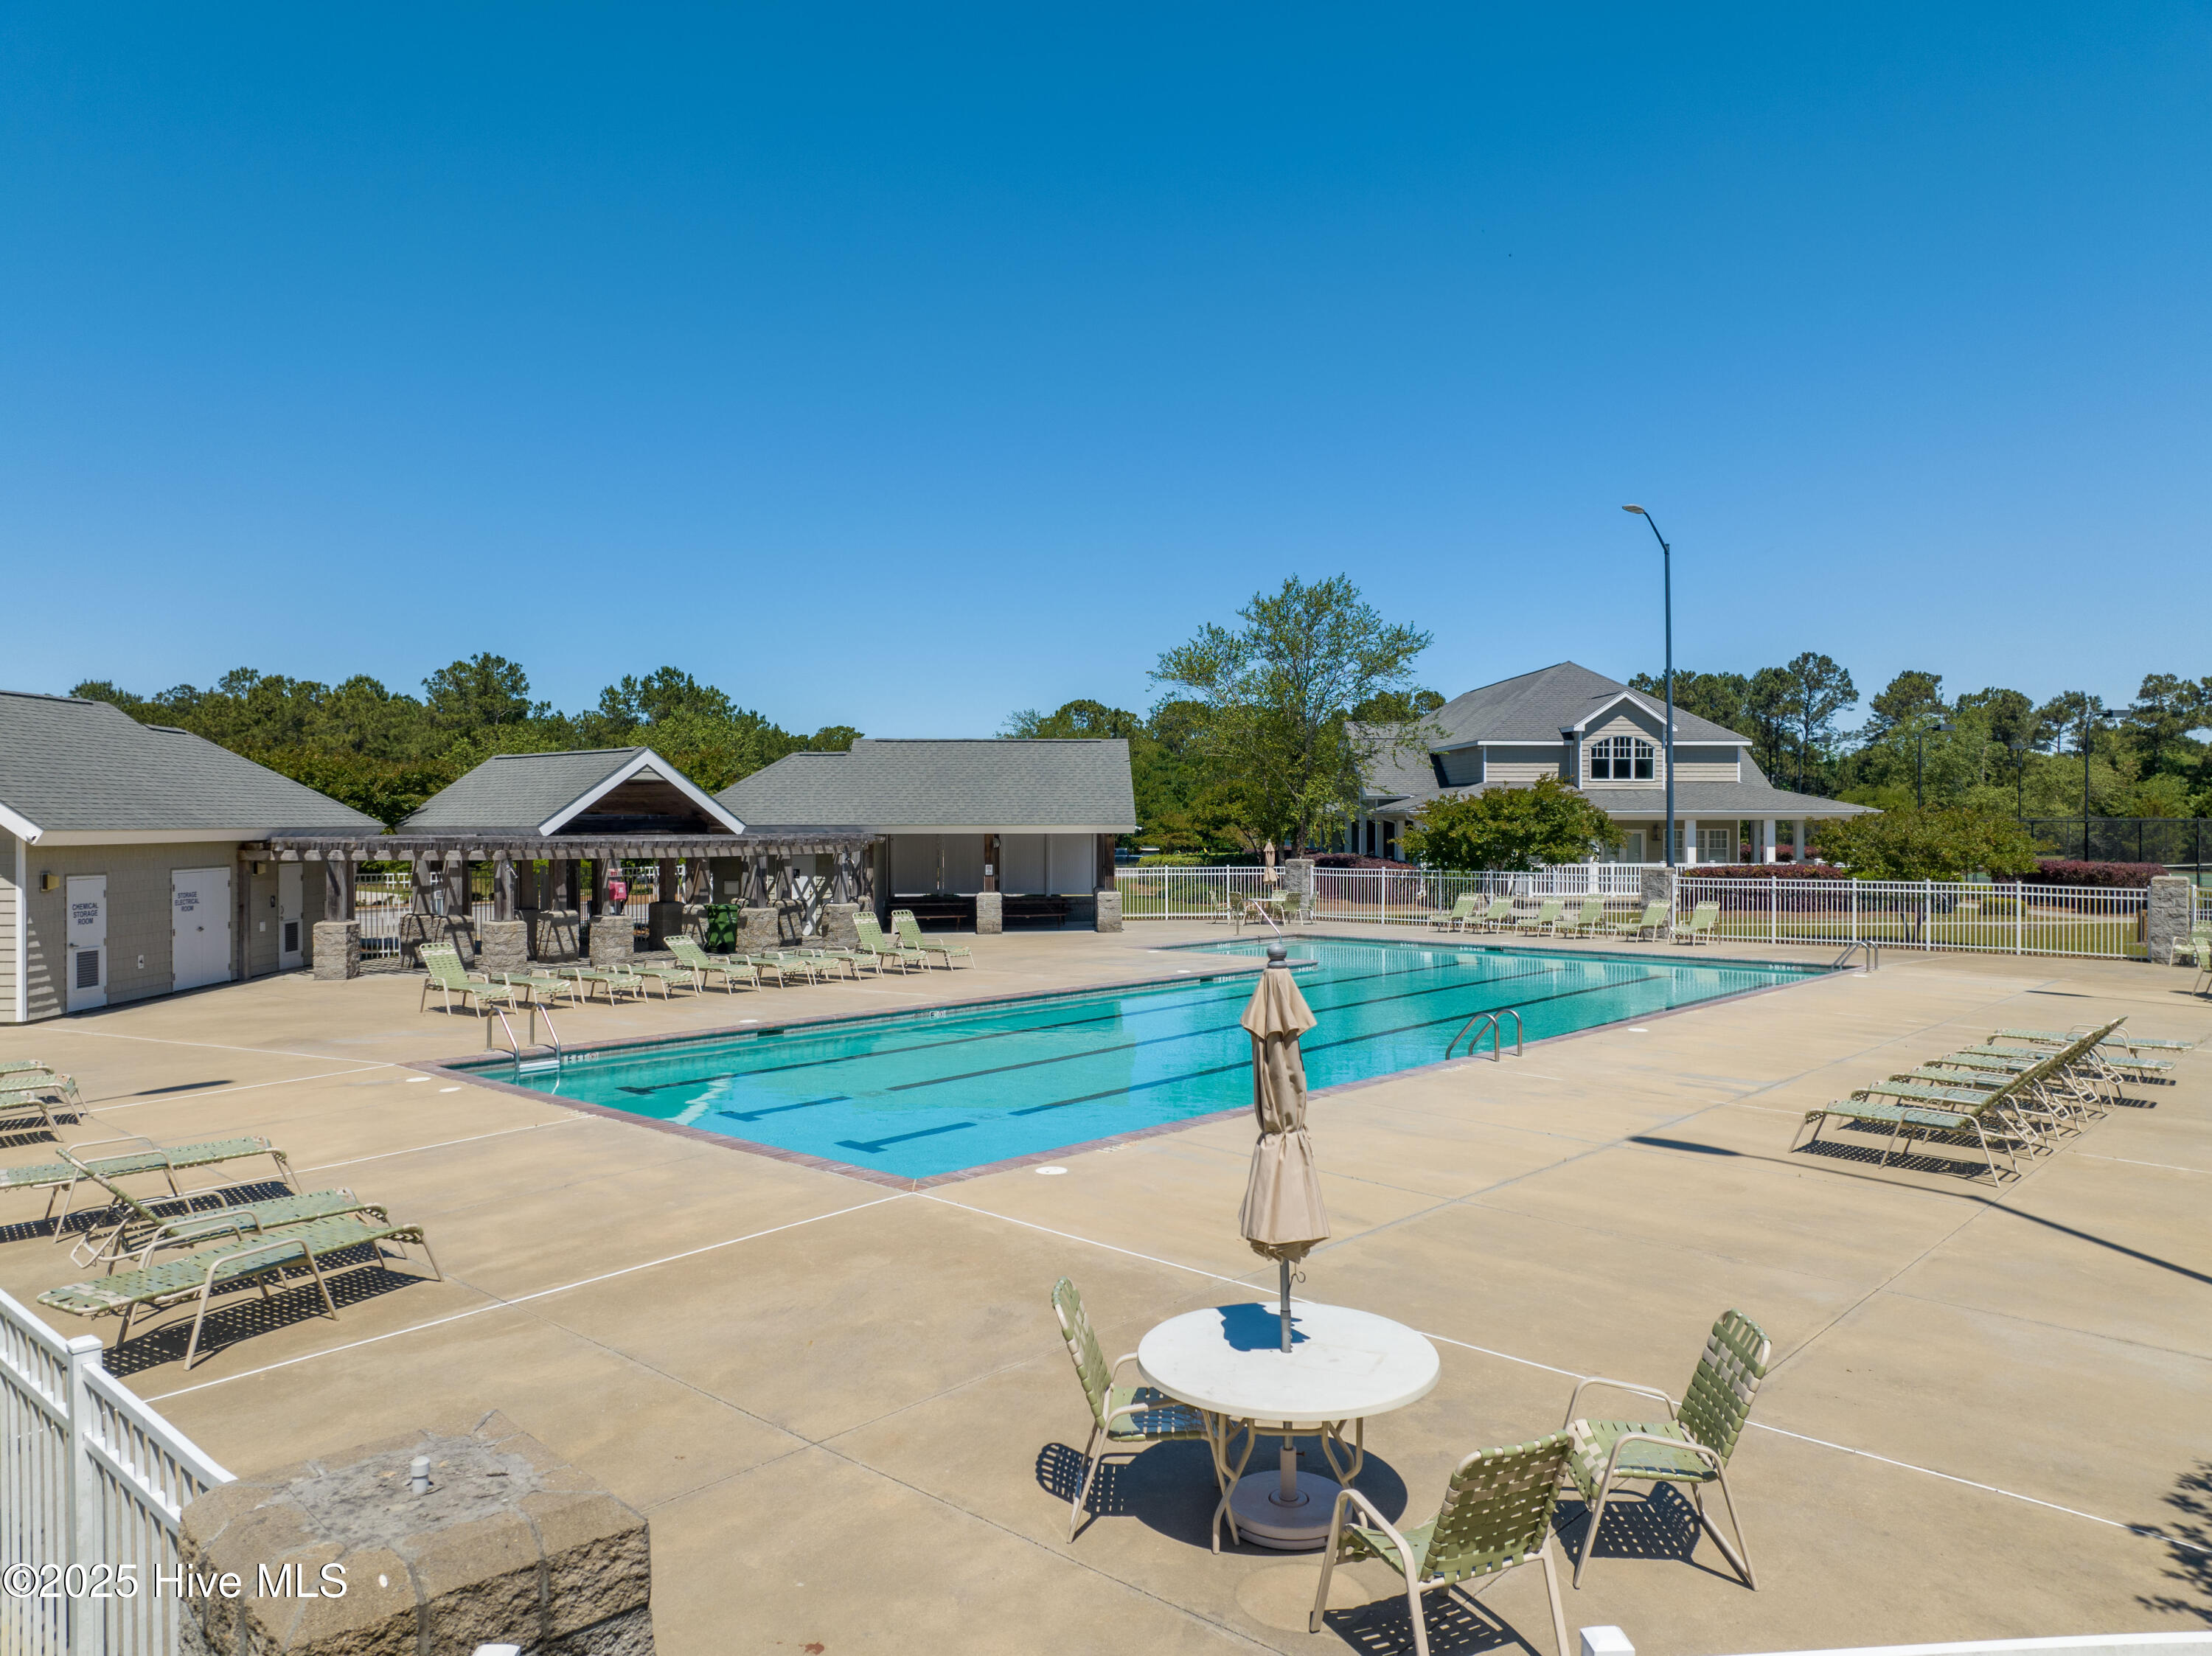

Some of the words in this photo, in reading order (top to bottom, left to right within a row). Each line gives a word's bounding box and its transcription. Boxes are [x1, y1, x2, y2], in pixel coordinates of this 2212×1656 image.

[72, 902, 99, 911] CHEMICAL
[73, 909, 98, 918] STORAGE
[77, 917, 94, 925] ROOM
